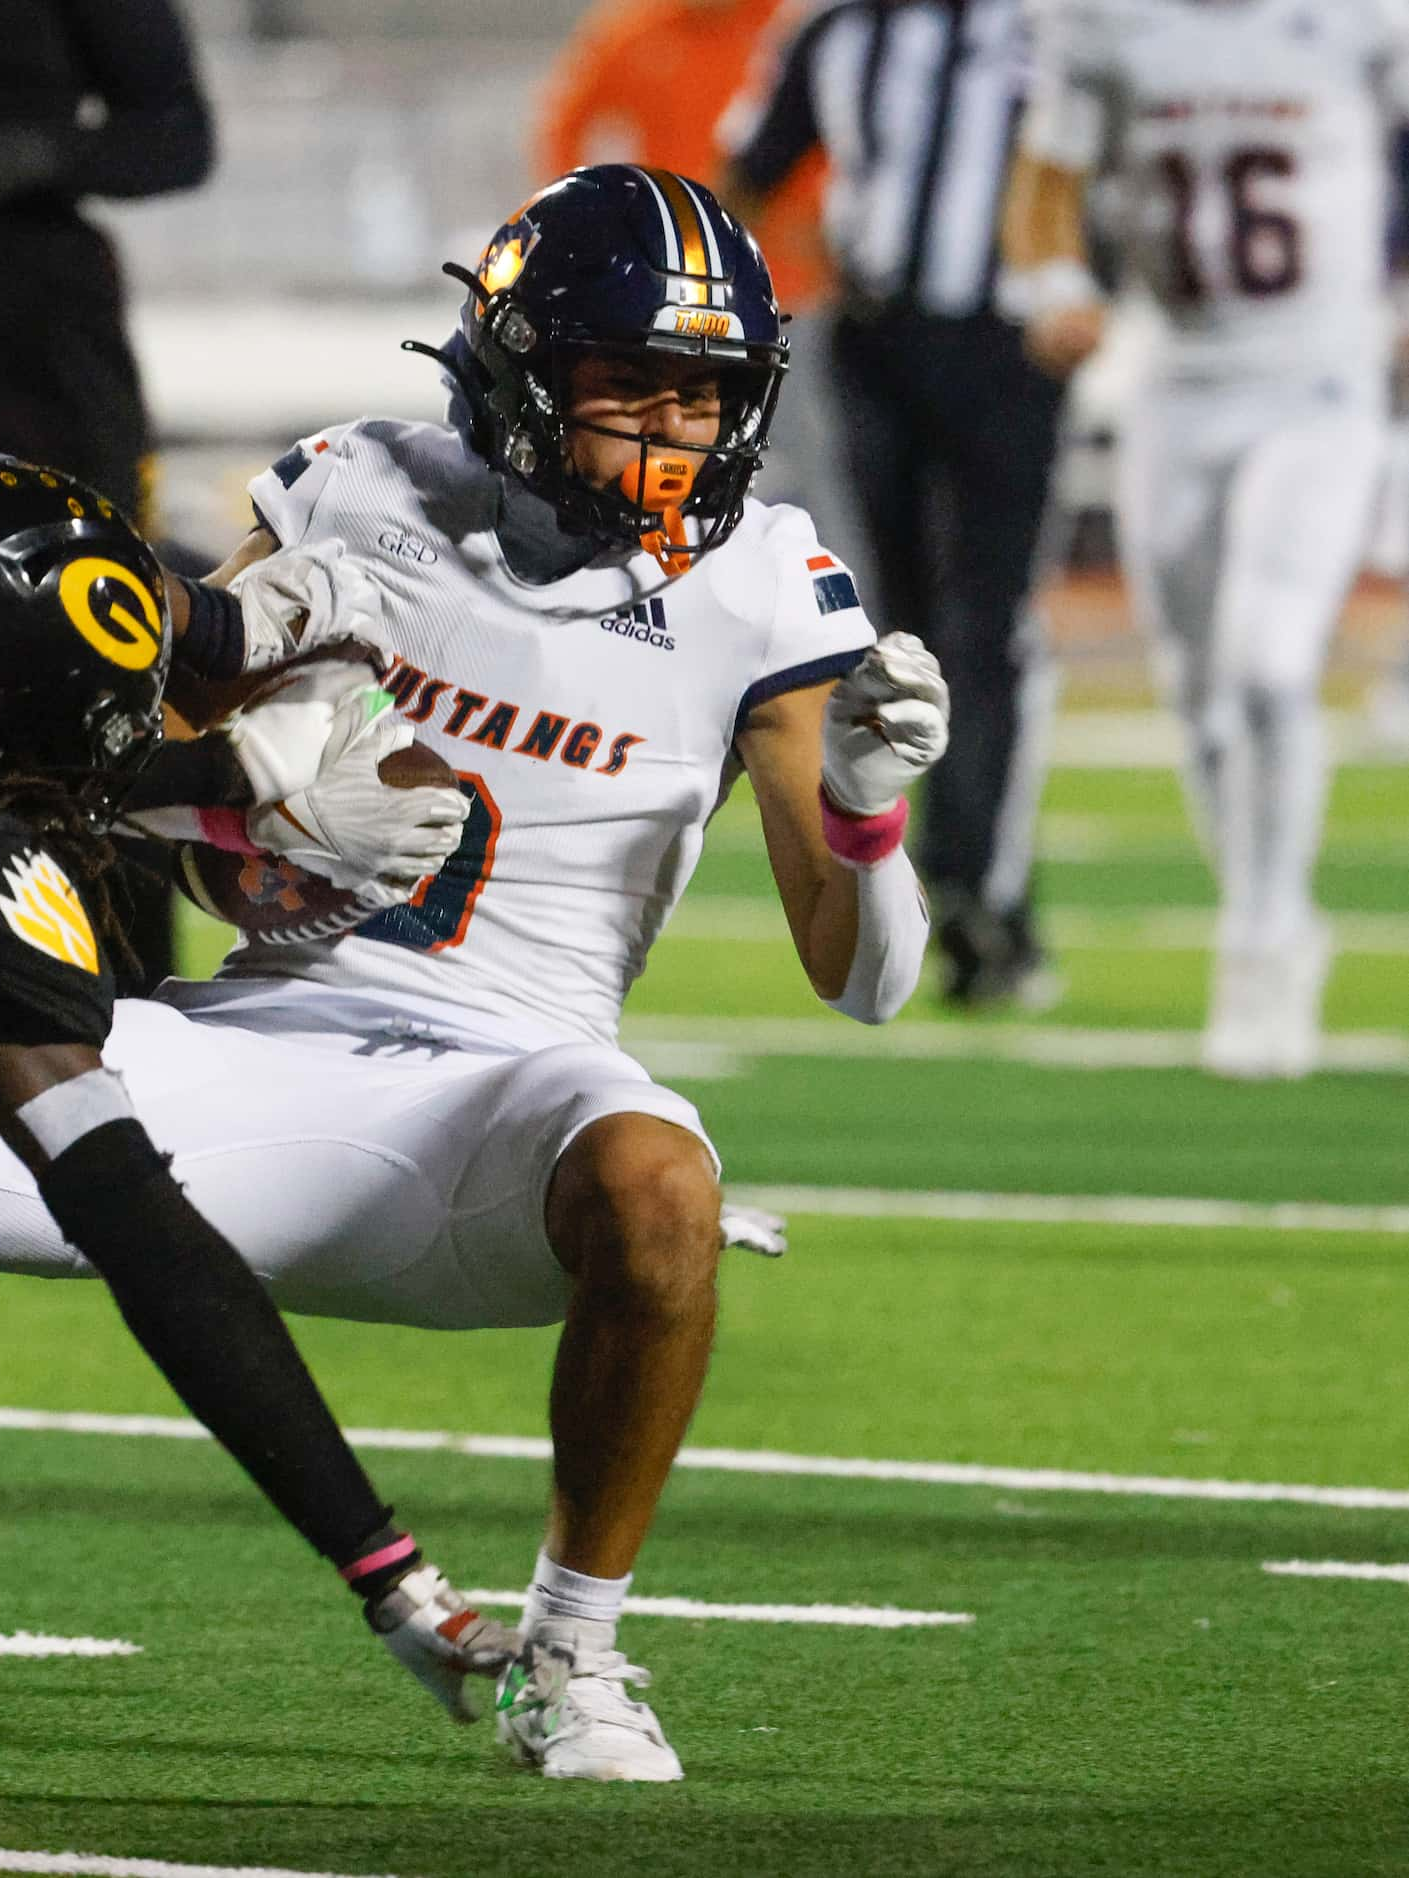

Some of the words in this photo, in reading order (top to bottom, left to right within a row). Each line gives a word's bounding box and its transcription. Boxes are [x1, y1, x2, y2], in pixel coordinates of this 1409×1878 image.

[1158, 144, 1302, 302] 16
[58, 557, 163, 671] G
[600, 618, 676, 650] adidas
[380, 652, 649, 778] USTANGS
